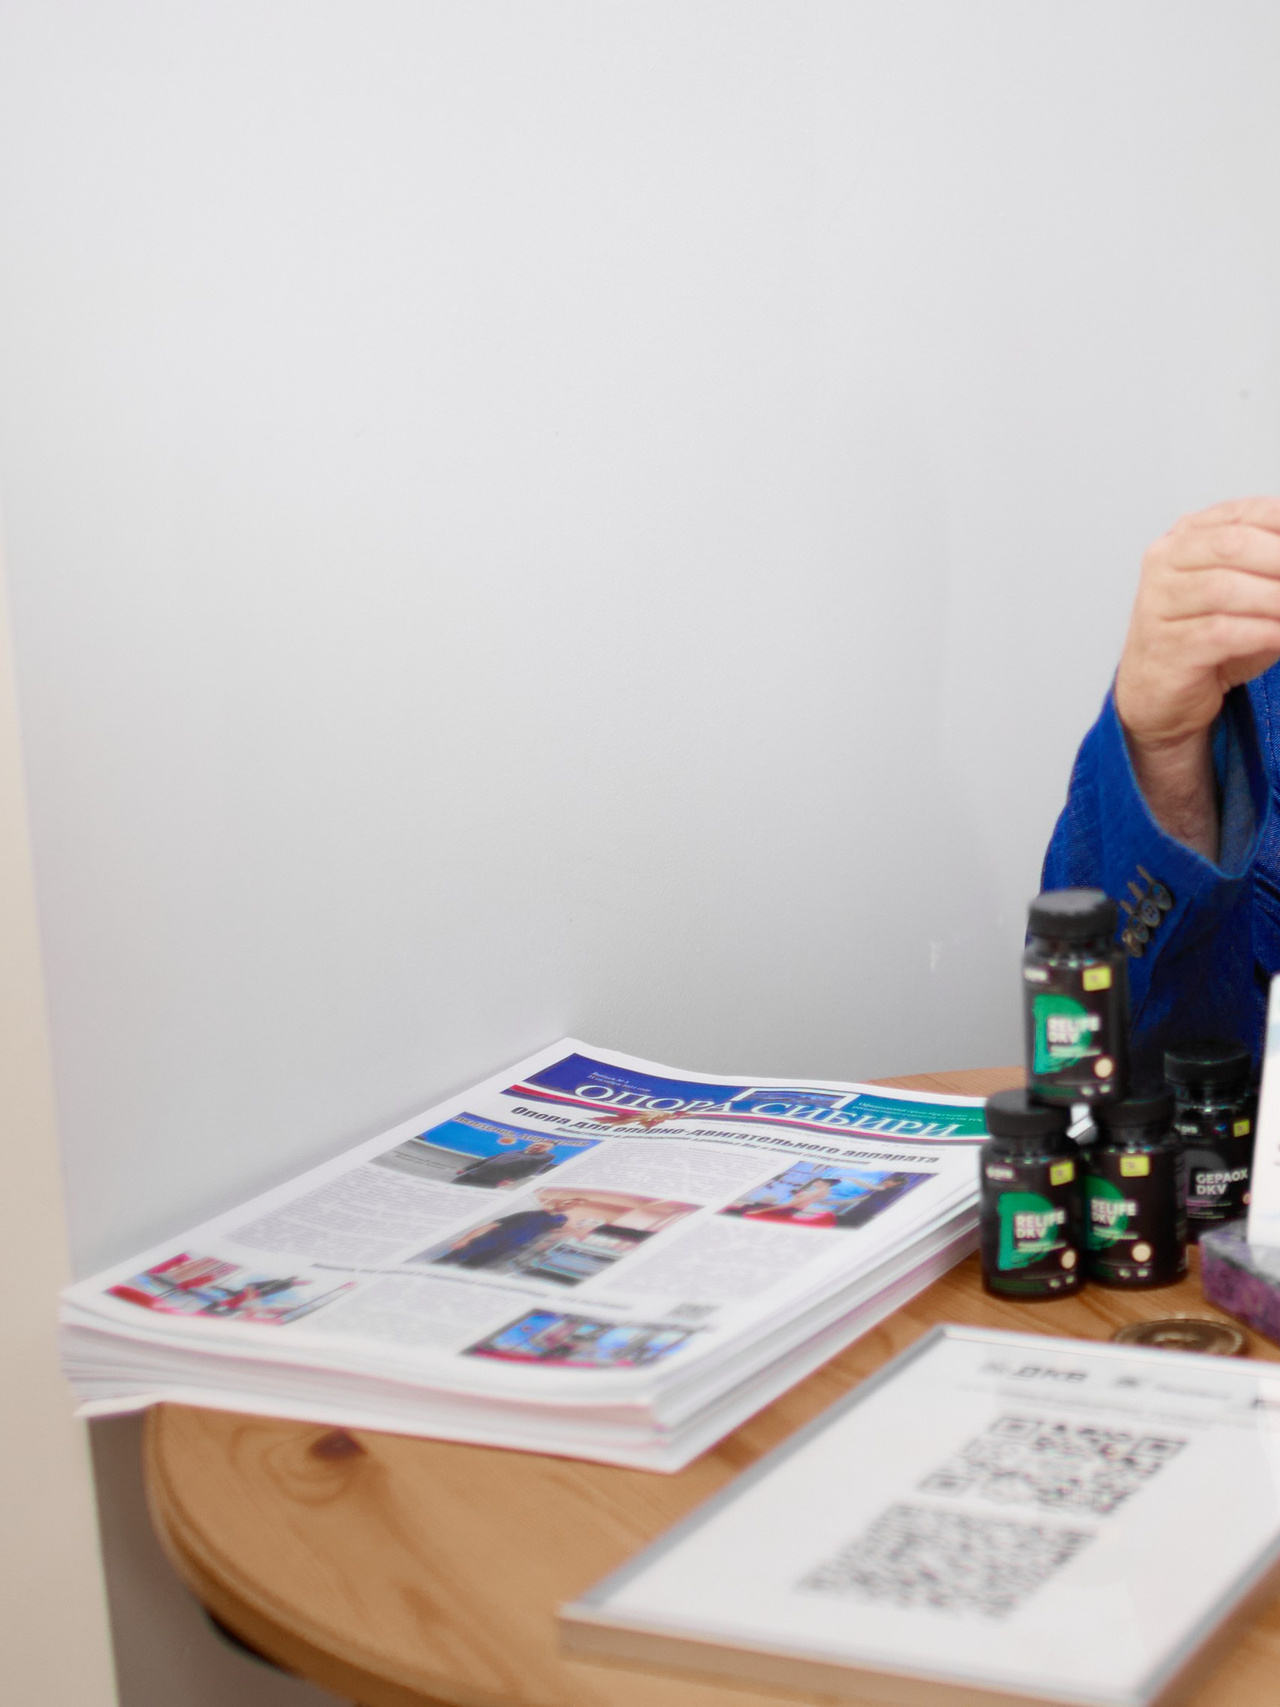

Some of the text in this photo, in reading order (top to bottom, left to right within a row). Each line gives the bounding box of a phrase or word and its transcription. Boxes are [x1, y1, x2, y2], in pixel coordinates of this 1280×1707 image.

[574, 1084, 966, 1137] ОПОРА СИБИРИ
[510, 1106, 571, 1125] Опора
[570, 1120, 611, 1132] для
[611, 1124, 841, 1154] опорно-двигательного
[842, 1149, 941, 1164] аппарата
[1195, 1168, 1248, 1184] GEPAOX
[1196, 1184, 1228, 1195] DKV
[1014, 1209, 1065, 1228] RELIFE
[1014, 1226, 1048, 1239] DKV
